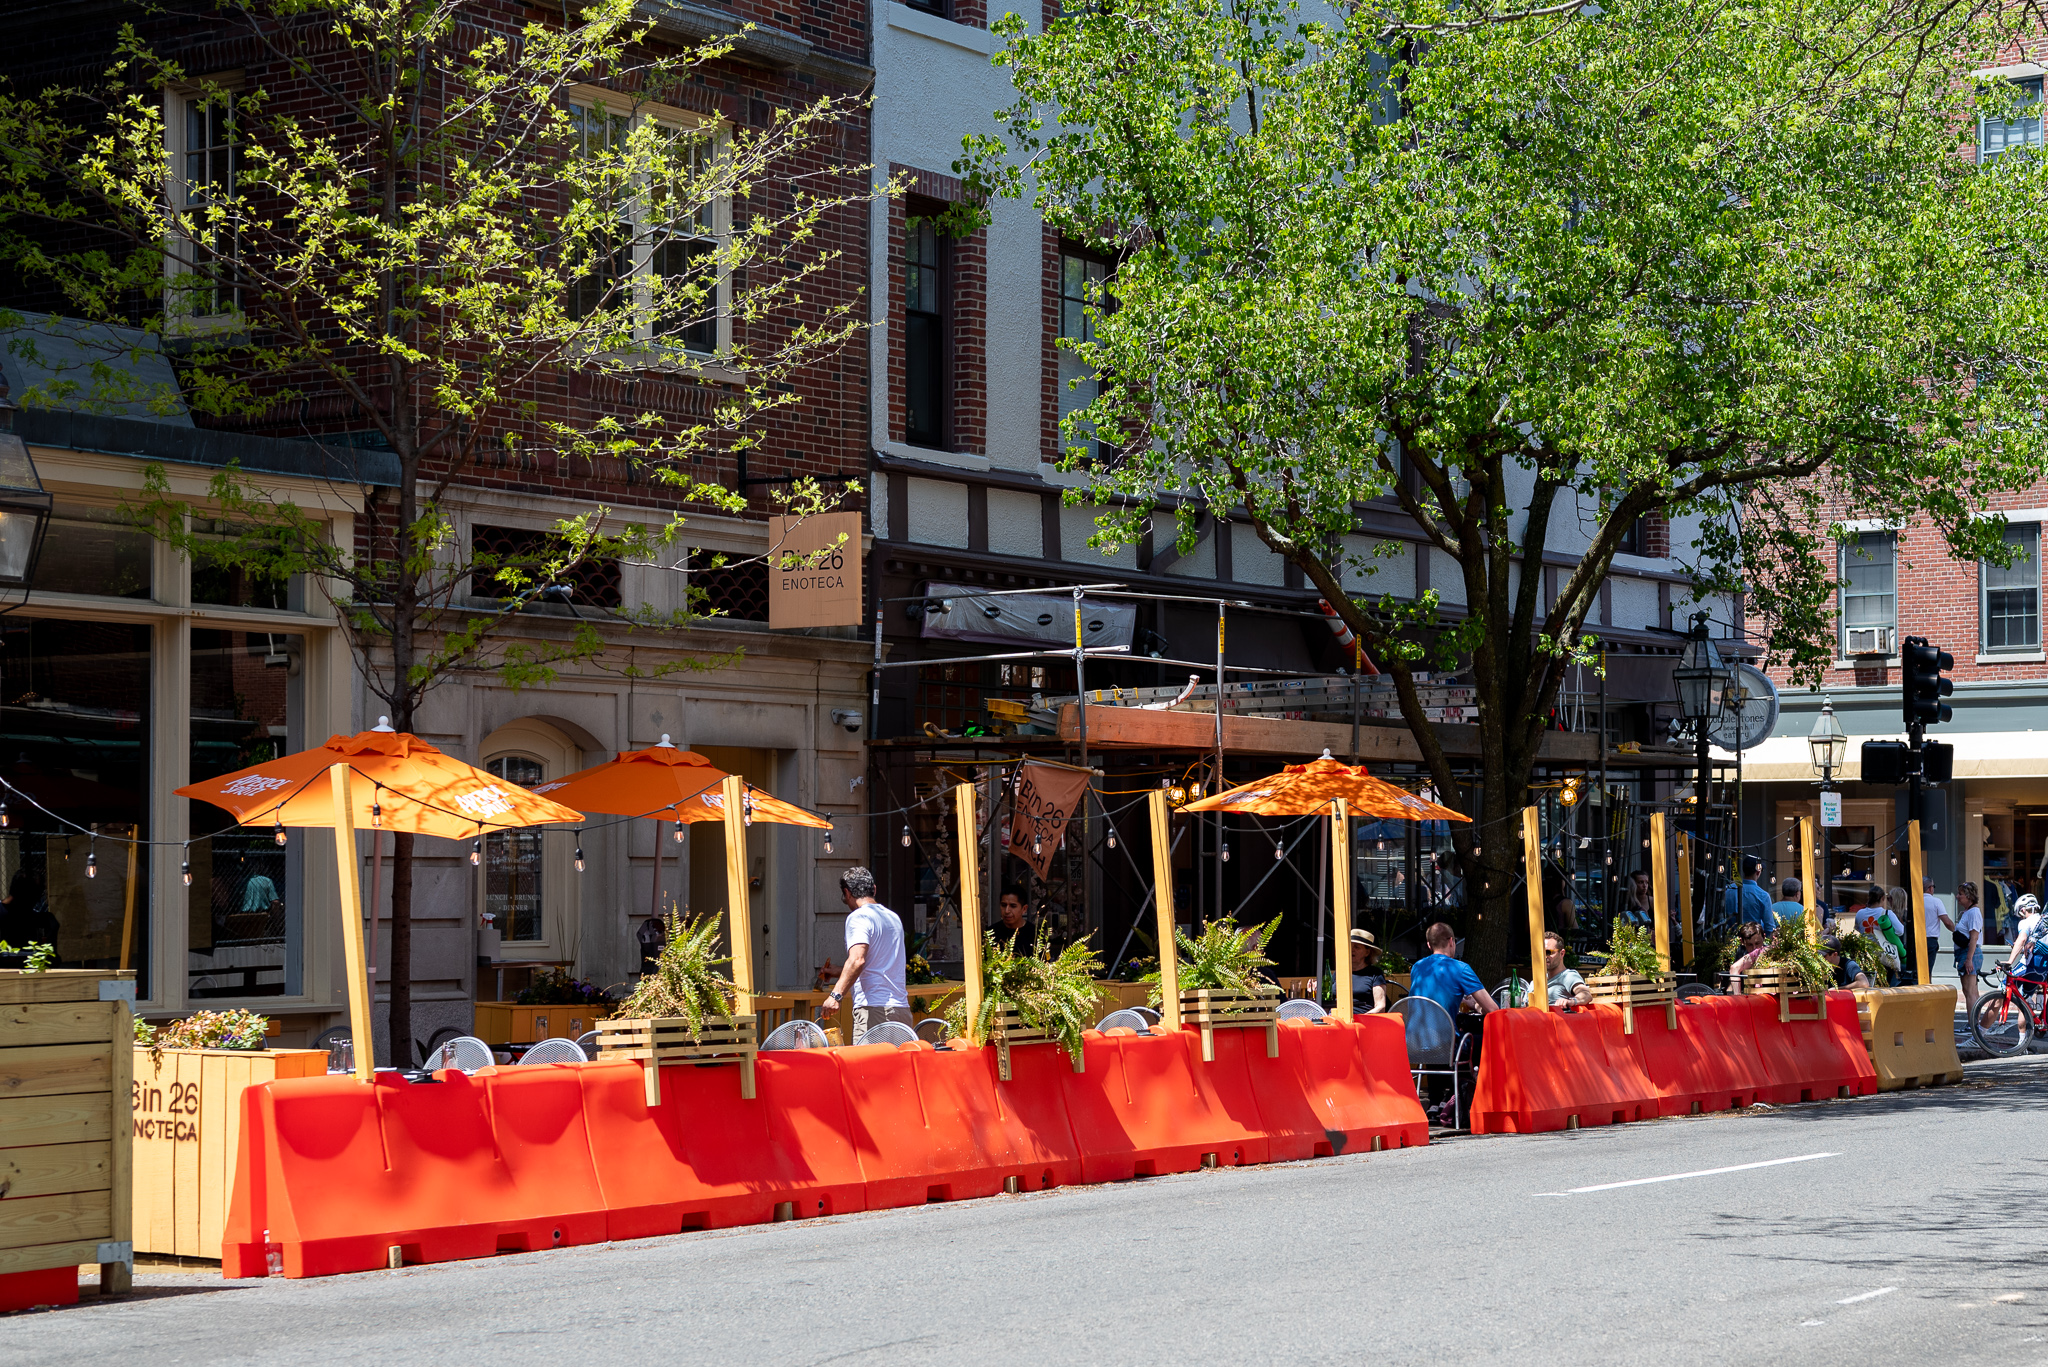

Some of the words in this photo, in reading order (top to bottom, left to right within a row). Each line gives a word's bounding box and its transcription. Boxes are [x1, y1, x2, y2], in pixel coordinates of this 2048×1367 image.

[818, 548, 844, 571] 26
[782, 576, 844, 591] ENOTECA
[1020, 778, 1042, 813] Bin
[1042, 802, 1064, 829] 26
[1012, 829, 1046, 870] UNCH
[168, 1082, 198, 1115] 26
[133, 1118, 198, 1142] NOTECA
